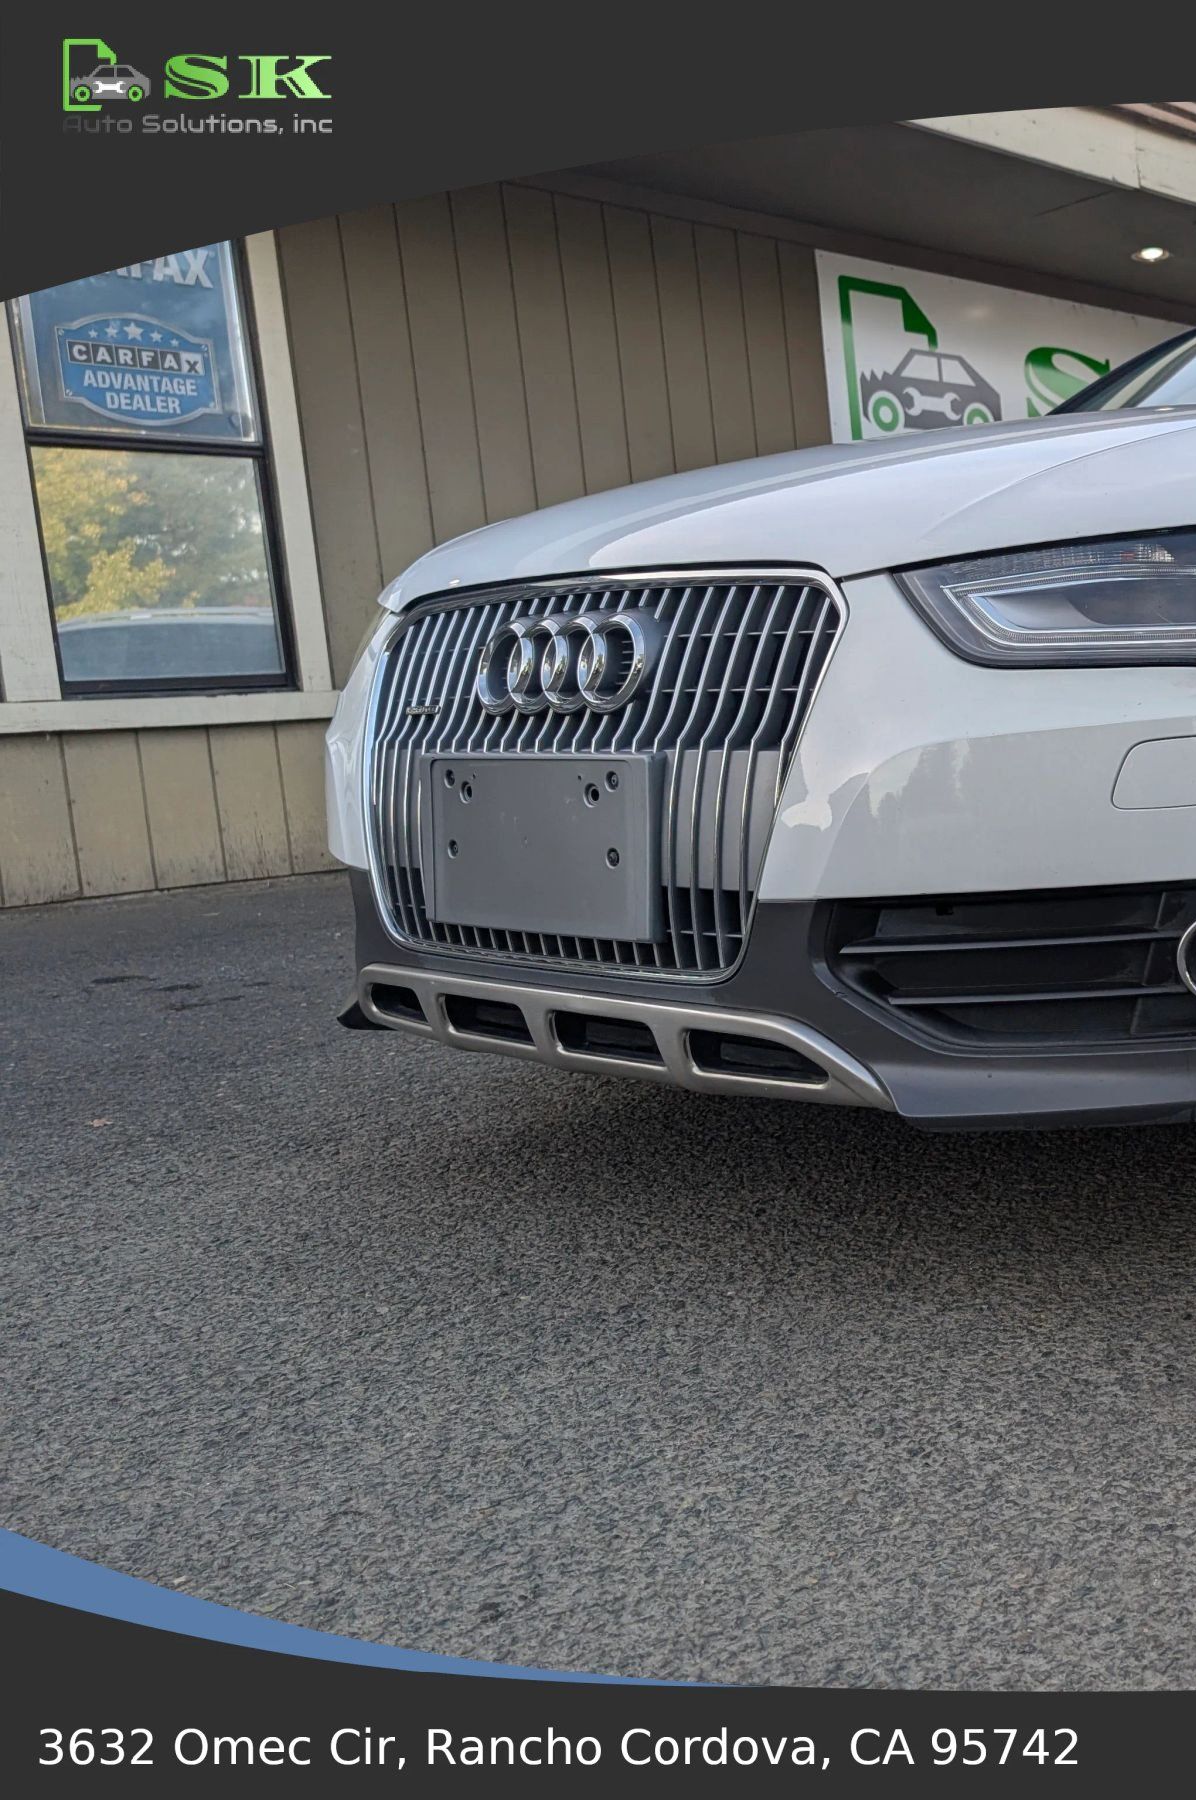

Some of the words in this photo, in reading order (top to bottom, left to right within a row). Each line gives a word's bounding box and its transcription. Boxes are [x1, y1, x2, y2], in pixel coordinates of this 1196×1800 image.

[72, 344, 200, 375] CARFAX
[83, 369, 198, 397] ADVANTAGE
[105, 391, 182, 415] DEALER
